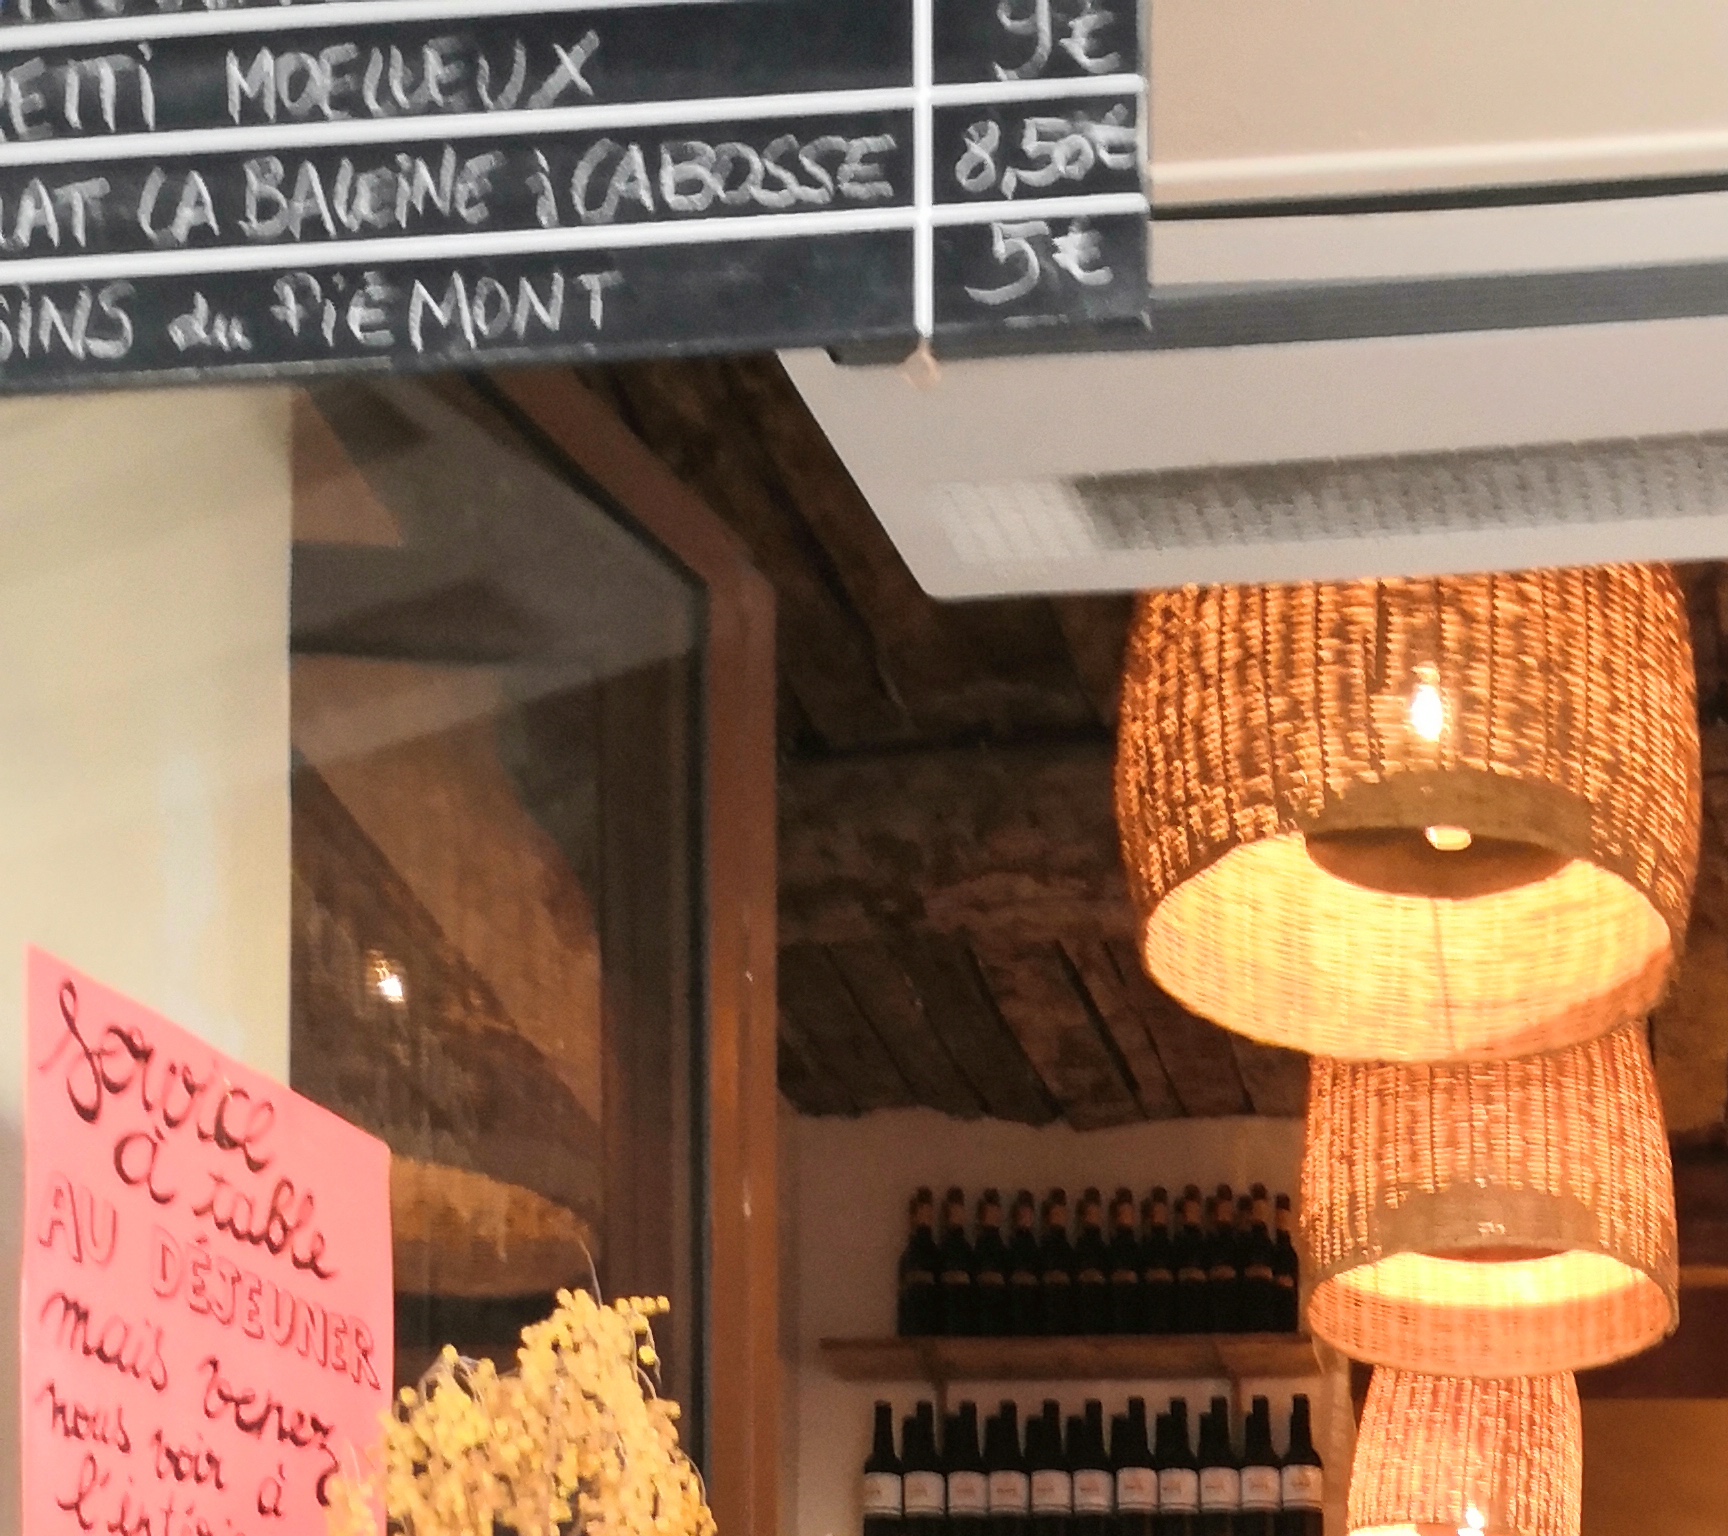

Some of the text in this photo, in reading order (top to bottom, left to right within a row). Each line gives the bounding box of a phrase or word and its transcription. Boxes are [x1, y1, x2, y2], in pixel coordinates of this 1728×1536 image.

[0, 177, 111, 250] AT
[137, 166, 219, 245] LA
[570, 133, 897, 225] CABOSSE
[965, 215, 1115, 305] 5€
[168, 292, 253, 352] du
[38, 980, 275, 1173] Service
[38, 1170, 118, 1267] AU
[113, 1126, 338, 1279] à table
[36, 1378, 131, 1453] nous
[153, 1428, 225, 1490] voir
[38, 1290, 340, 1508] mais venez
